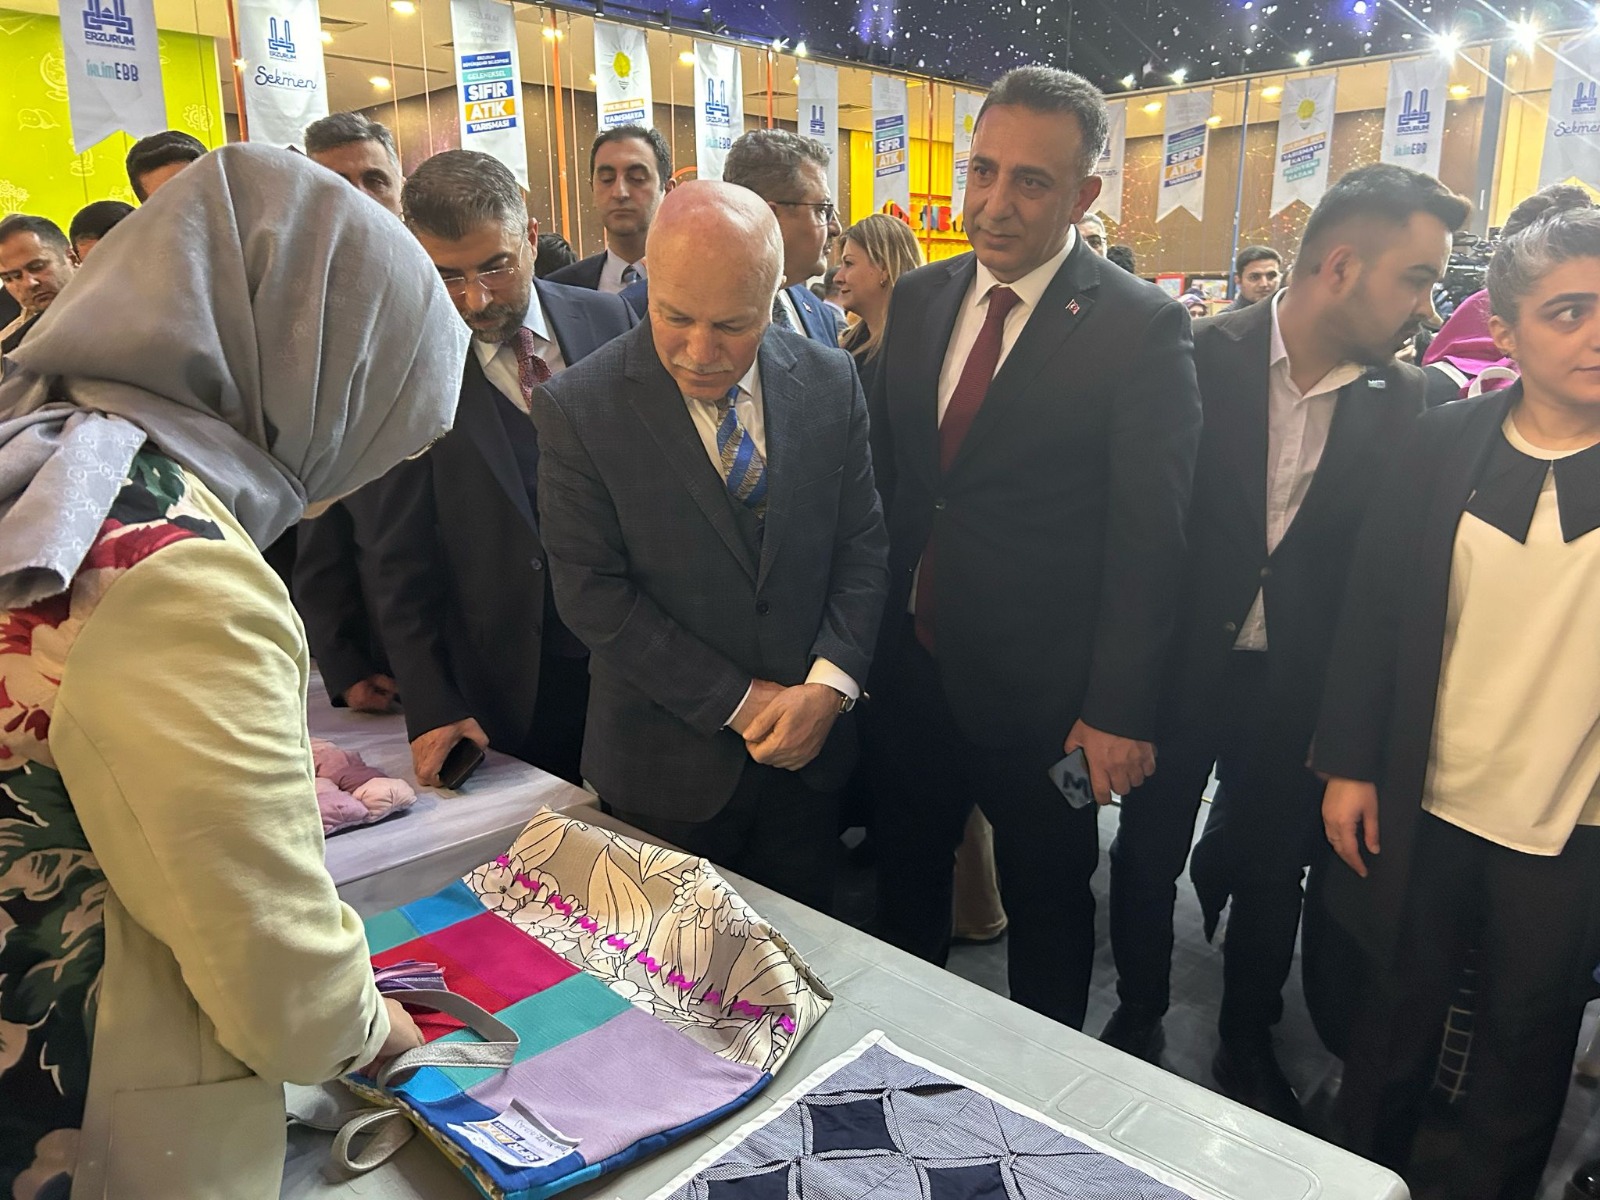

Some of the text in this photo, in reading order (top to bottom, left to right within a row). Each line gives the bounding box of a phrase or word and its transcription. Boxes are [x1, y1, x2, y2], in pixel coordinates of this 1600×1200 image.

[84, 30, 135, 46] ERZURUM
[269, 50, 297, 59] ERZURUM
[254, 65, 317, 90] Sekmen
[468, 81, 508, 101] SIFIR
[470, 100, 508, 120] ATIK
[1553, 121, 1600, 137] Sekme
[878, 137, 901, 152] SIFIR
[879, 151, 900, 167] ATIK
[1170, 146, 1201, 164] SIFIR
[1169, 159, 1198, 178] ATIK
